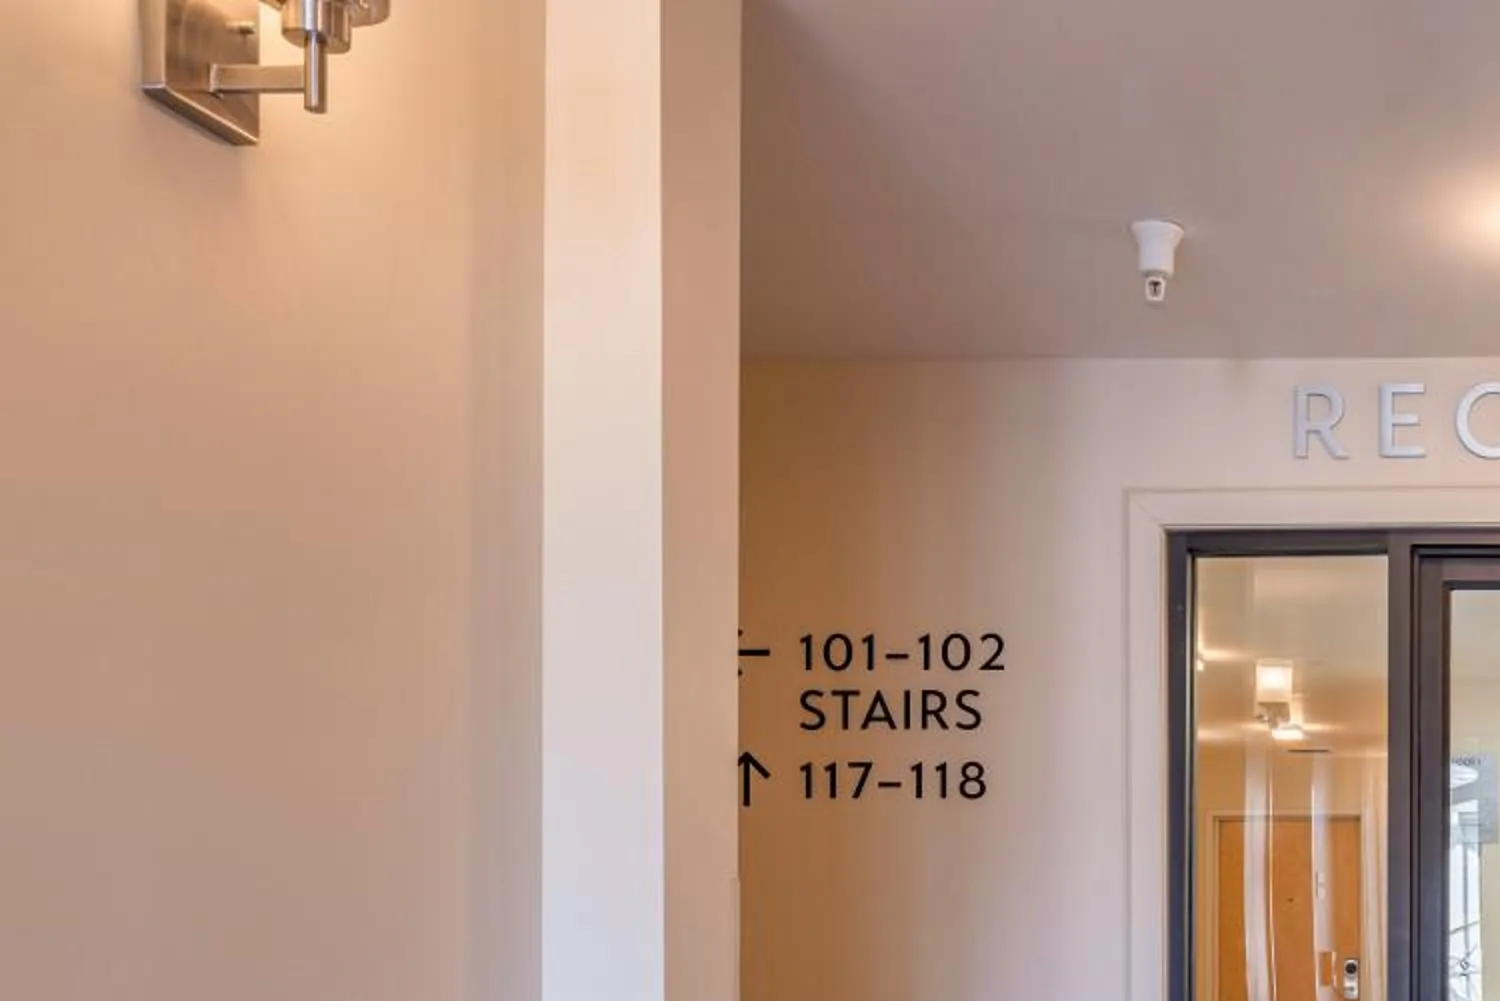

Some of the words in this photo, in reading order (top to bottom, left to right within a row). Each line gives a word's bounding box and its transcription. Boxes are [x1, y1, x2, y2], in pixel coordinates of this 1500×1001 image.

[799, 632, 1005, 672] 101-102
[799, 689, 982, 731] STAIRS
[799, 761, 987, 800] 117-118
